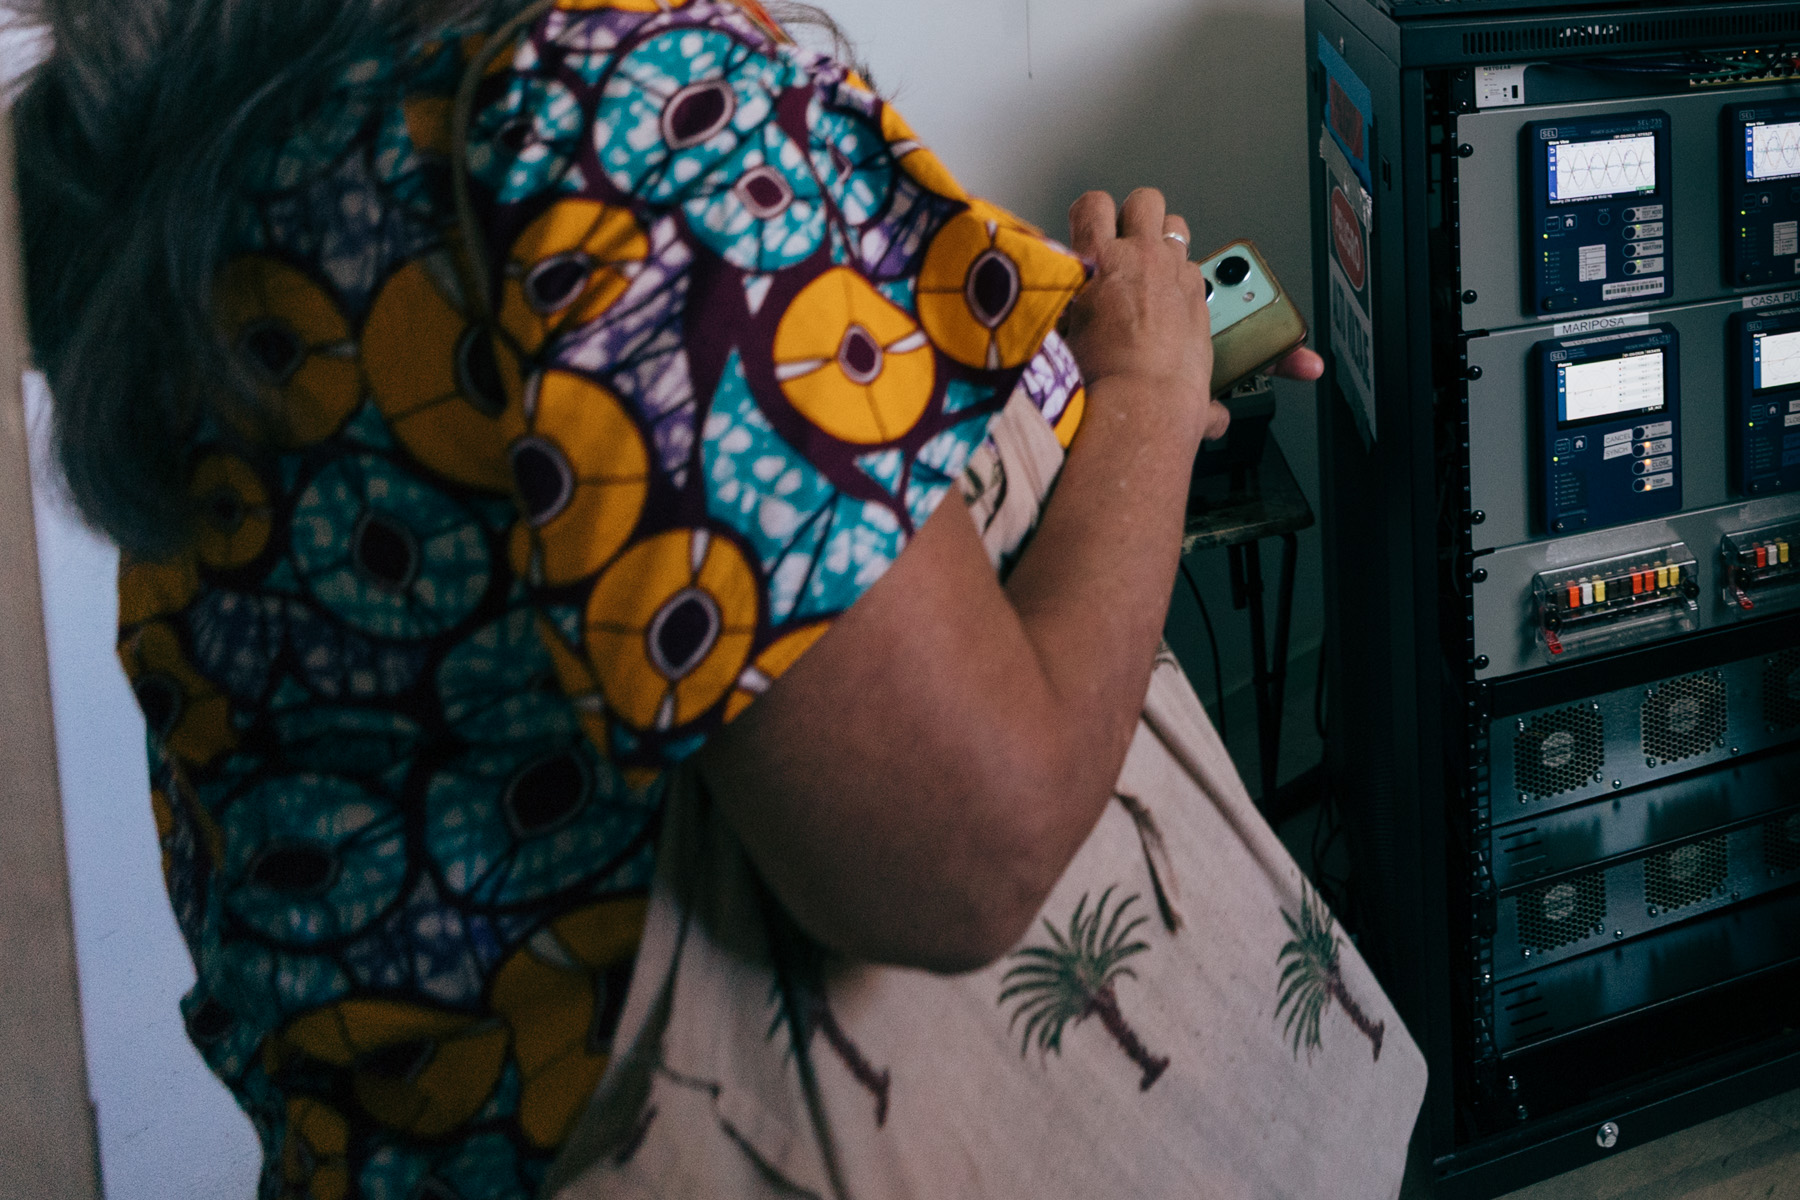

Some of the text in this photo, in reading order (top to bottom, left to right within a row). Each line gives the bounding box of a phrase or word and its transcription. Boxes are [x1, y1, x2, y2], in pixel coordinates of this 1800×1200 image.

[1541, 129, 1555, 138] SEL
[1751, 294, 1781, 307] CASA
[1562, 317, 1626, 335] MARIPOSA
[1552, 352, 1566, 360] SEL
[1606, 433, 1631, 443] CANCEL
[1606, 446, 1628, 457] SYNCH
[1652, 460, 1669, 468] CLOSE
